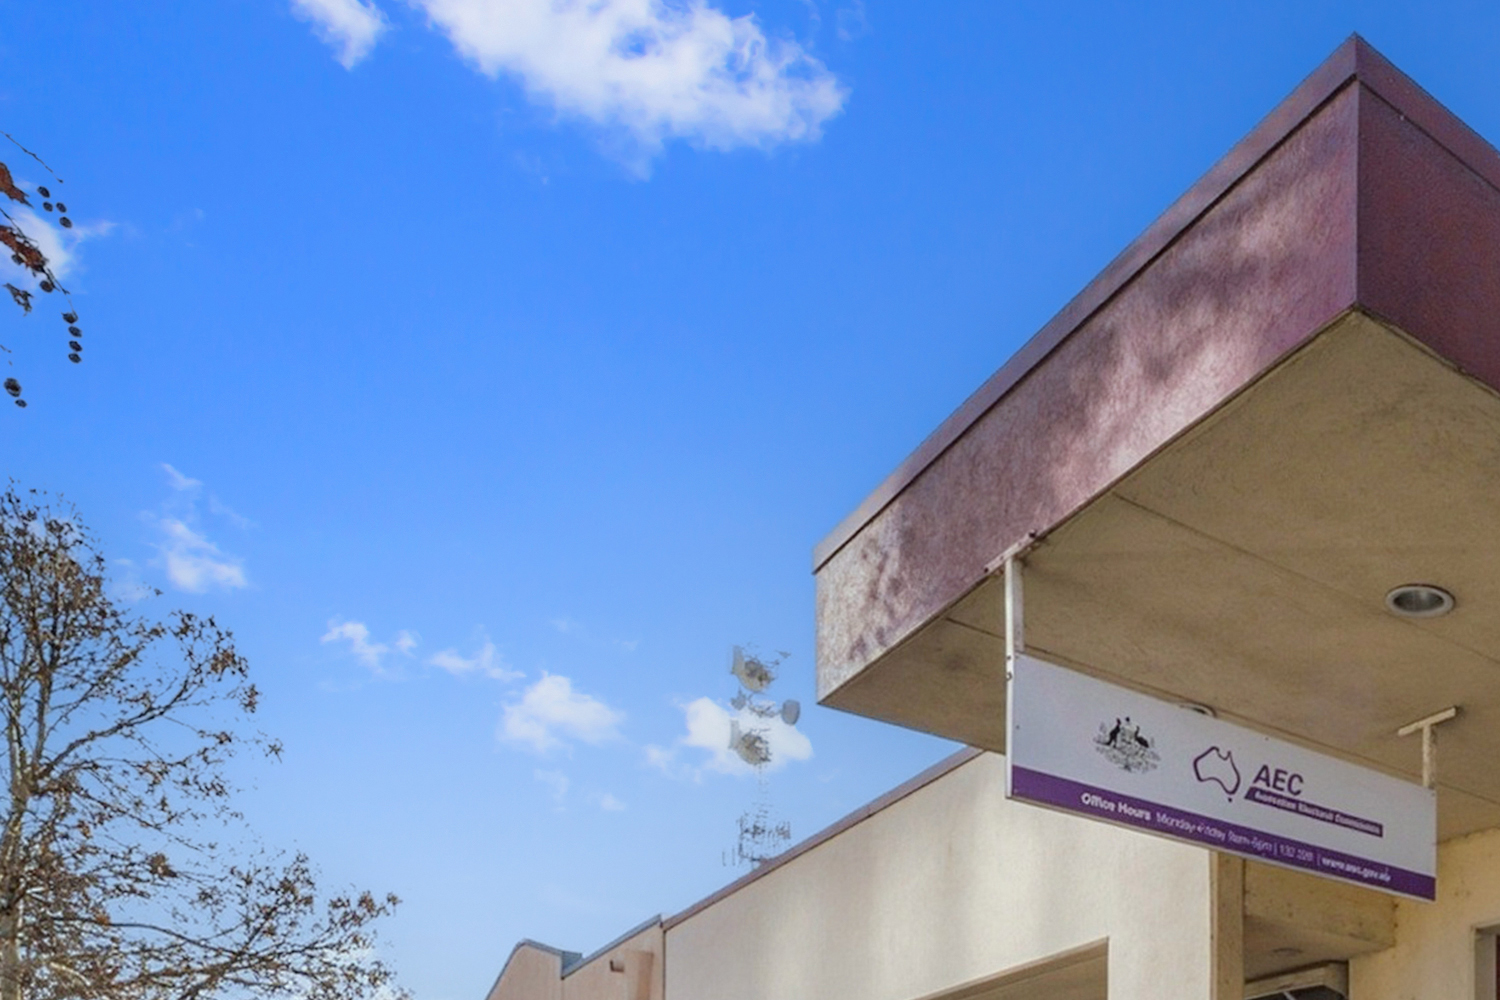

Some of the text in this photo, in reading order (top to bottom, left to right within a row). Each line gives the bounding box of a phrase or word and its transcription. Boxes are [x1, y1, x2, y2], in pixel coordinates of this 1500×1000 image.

[1253, 764, 1304, 796] AEC
[1081, 792, 1115, 811] Office
[1117, 801, 1151, 821] Hours
